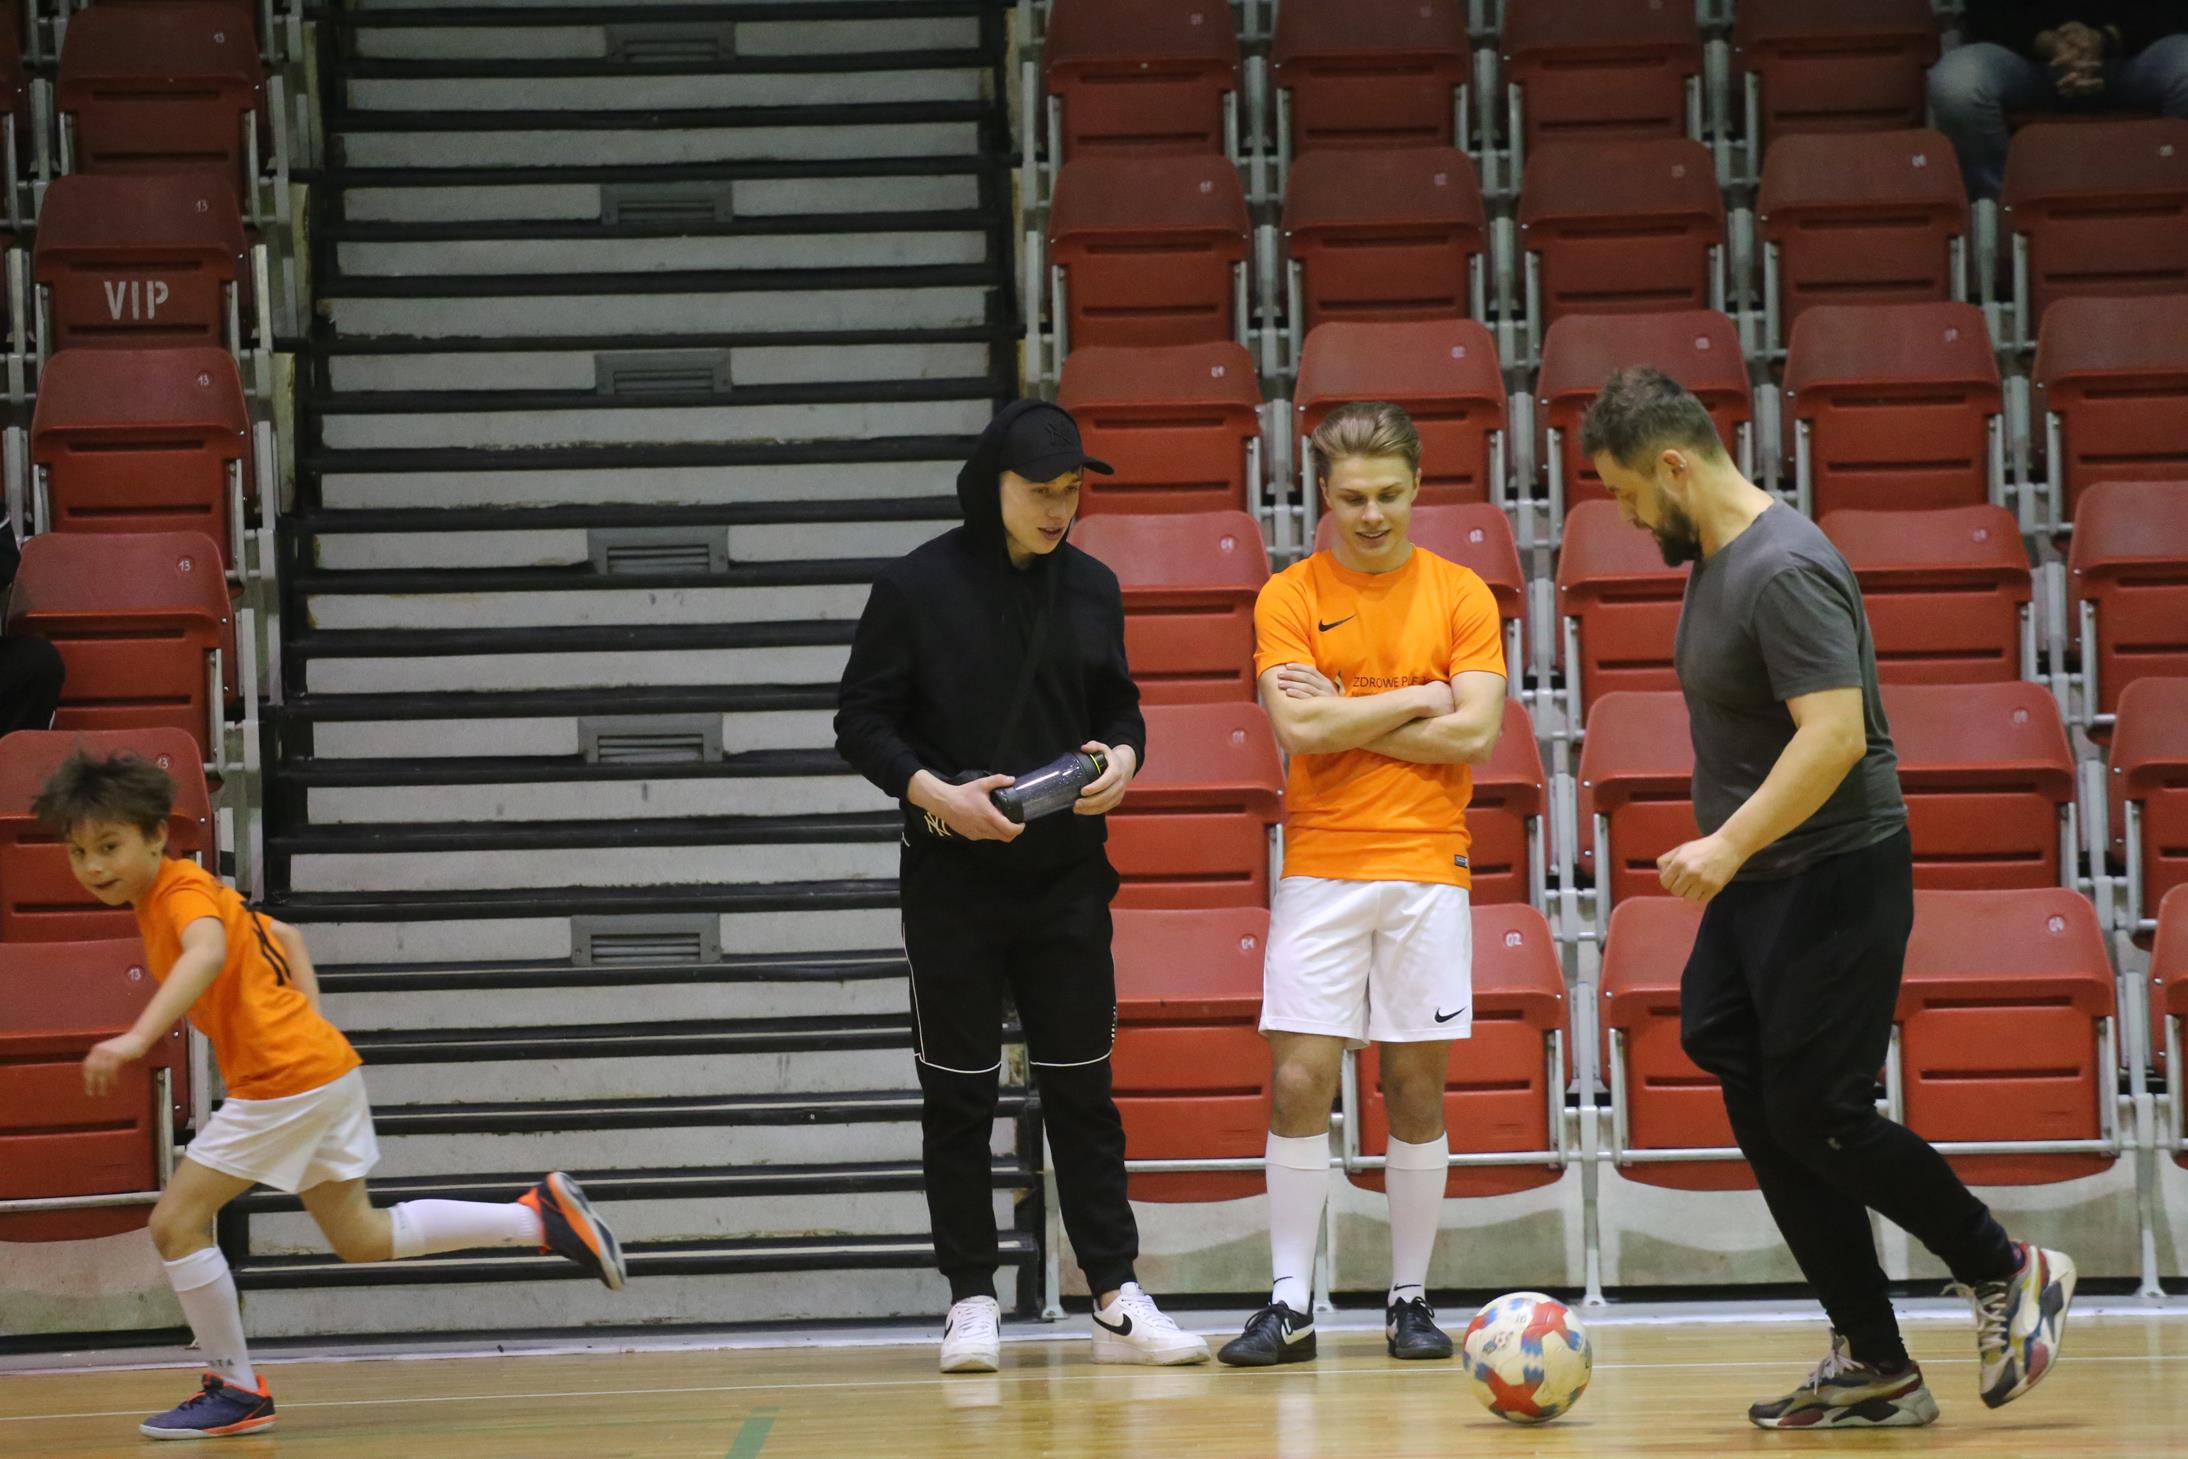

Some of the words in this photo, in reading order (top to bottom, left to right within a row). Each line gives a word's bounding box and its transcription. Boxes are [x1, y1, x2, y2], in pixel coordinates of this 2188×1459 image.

[213, 32, 224, 43] 13
[195, 199, 208, 213] 13
[104, 280, 169, 320] VIP
[197, 374, 209, 385] 13
[178, 559, 191, 573] 13
[1352, 676, 1398, 688] ZDROWE
[156, 757, 168, 770] 13
[1505, 932, 1522, 947] 02
[128, 968, 141, 981] 13
